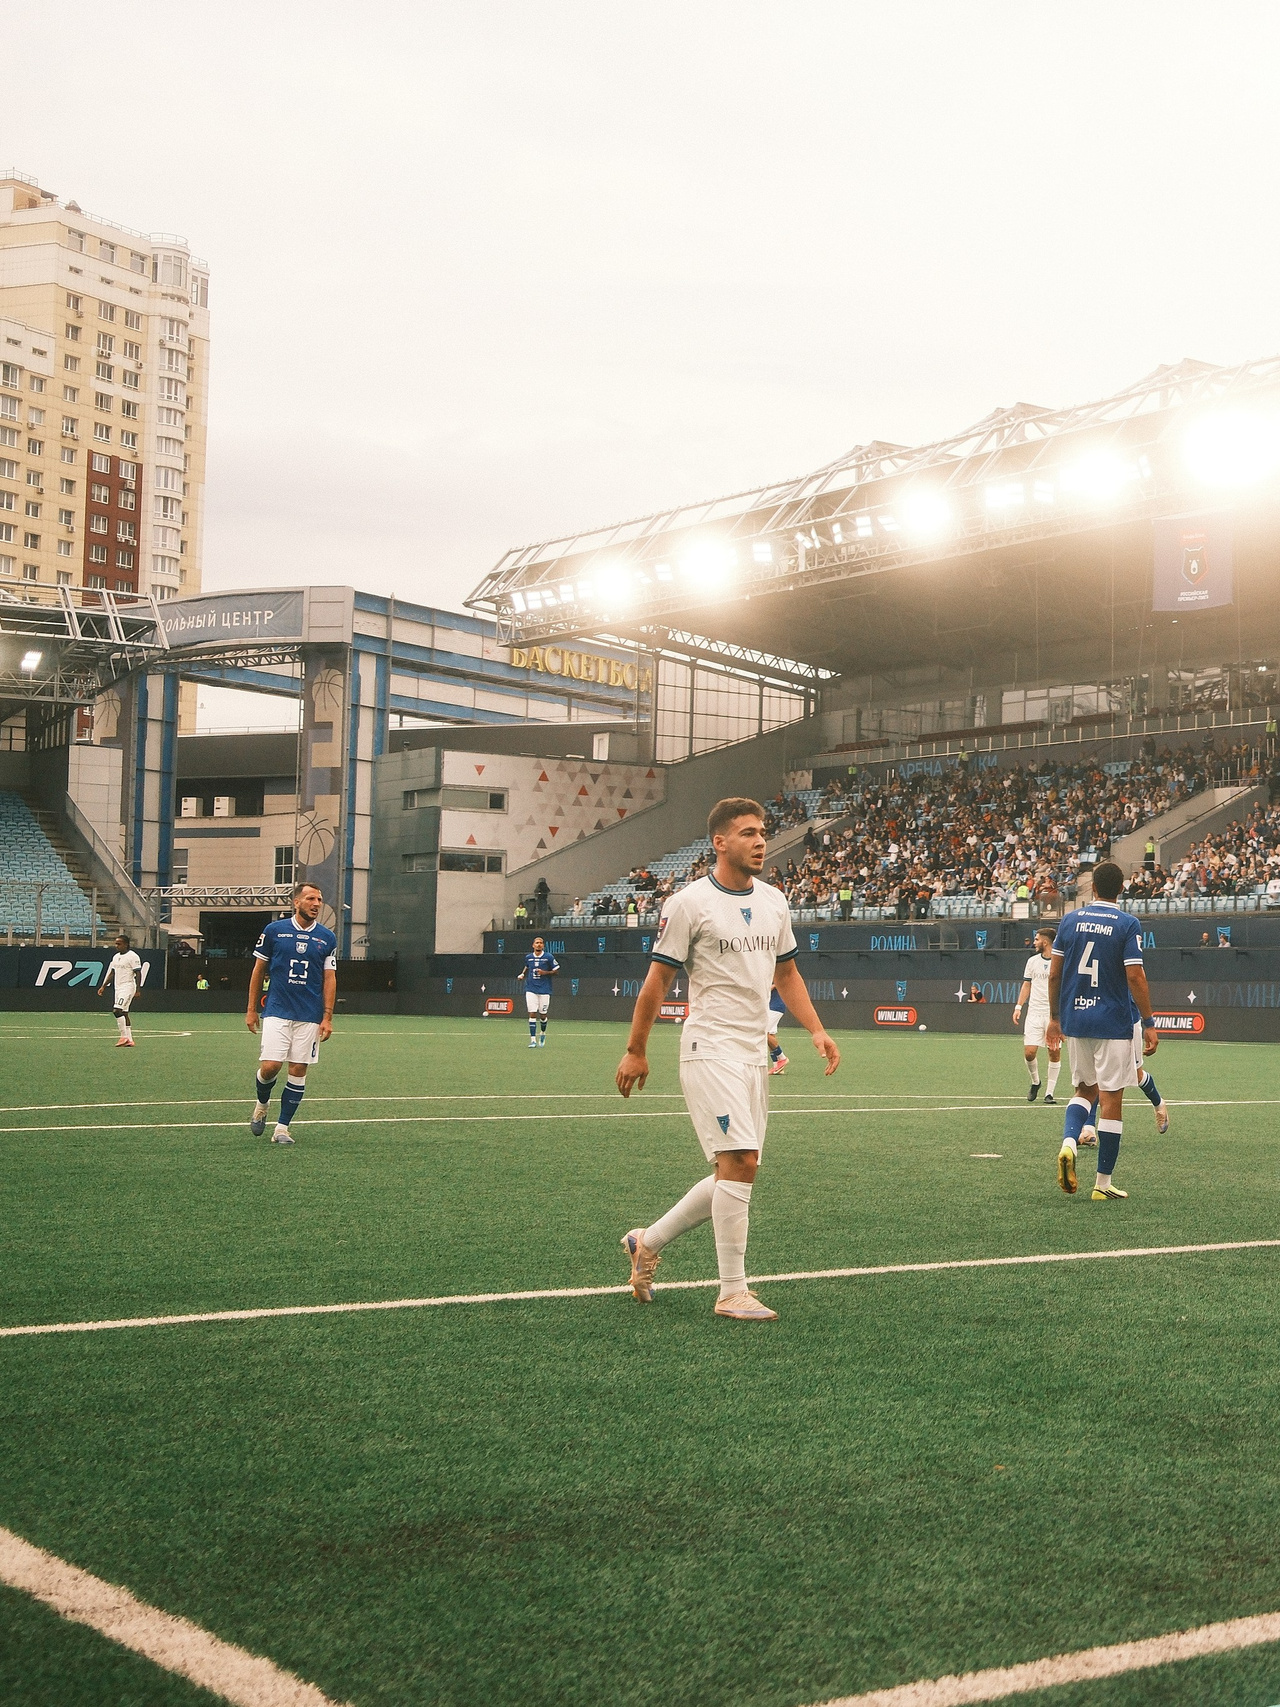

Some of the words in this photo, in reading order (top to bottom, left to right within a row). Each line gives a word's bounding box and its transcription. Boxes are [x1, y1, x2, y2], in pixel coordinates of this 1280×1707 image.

[221, 610, 274, 629] ЦЕНТР
[1075, 922, 1113, 937] ГАССАМА
[719, 935, 776, 954] РОДИНА
[1077, 941, 1099, 988] 4
[660, 1006, 685, 1016] WINLINE
[877, 1011, 909, 1022] WINLINE
[1154, 1017, 1193, 1029] WINLINE
